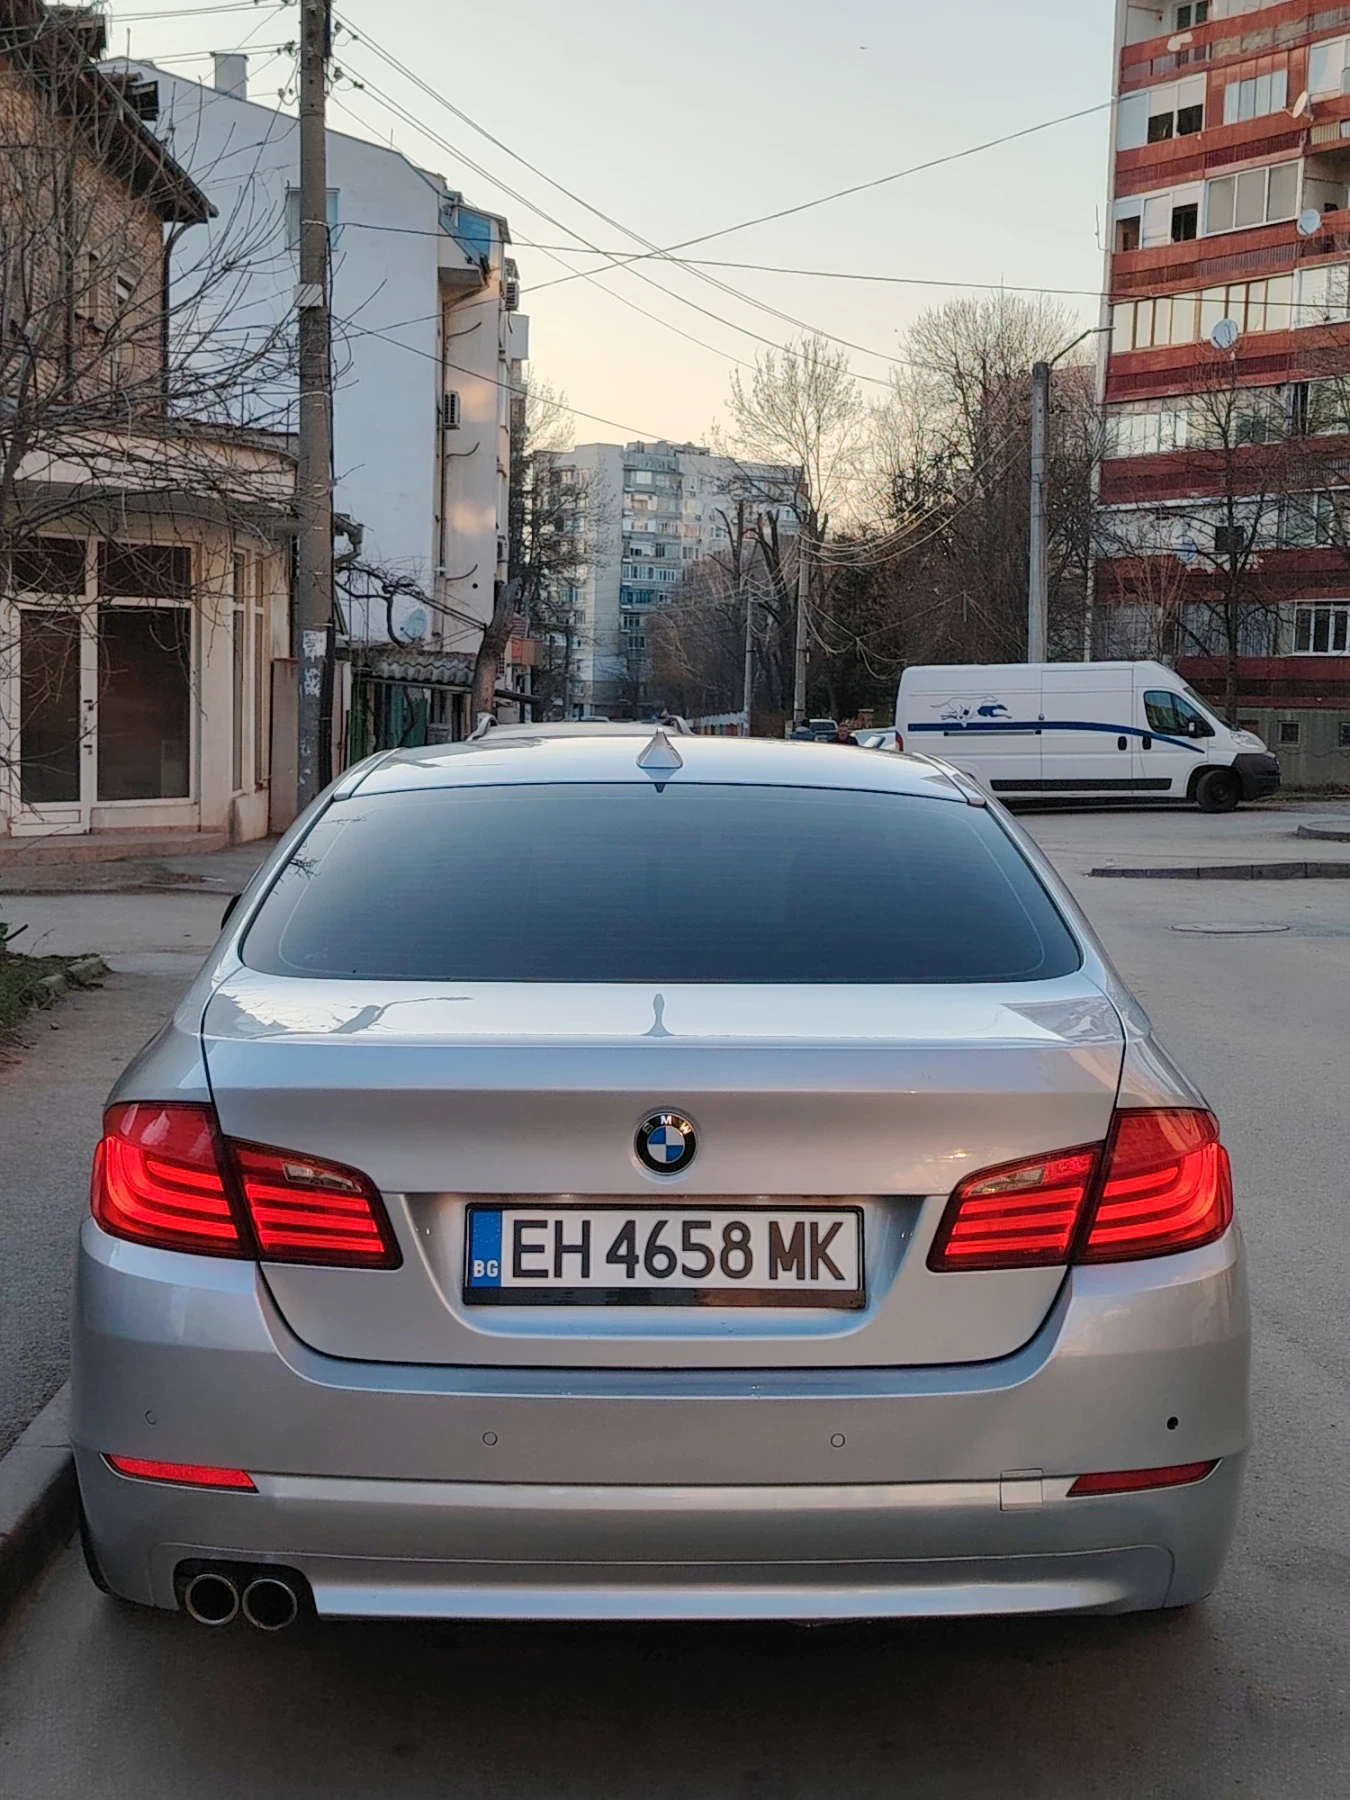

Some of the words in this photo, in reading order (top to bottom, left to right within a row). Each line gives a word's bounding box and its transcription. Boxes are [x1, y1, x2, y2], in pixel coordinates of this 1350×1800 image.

[641, 1115, 692, 1135] BMW
[512, 1219, 591, 1279] EH
[605, 1219, 753, 1280] 4658
[768, 1220, 846, 1281] MK
[474, 1259, 499, 1278] BG
